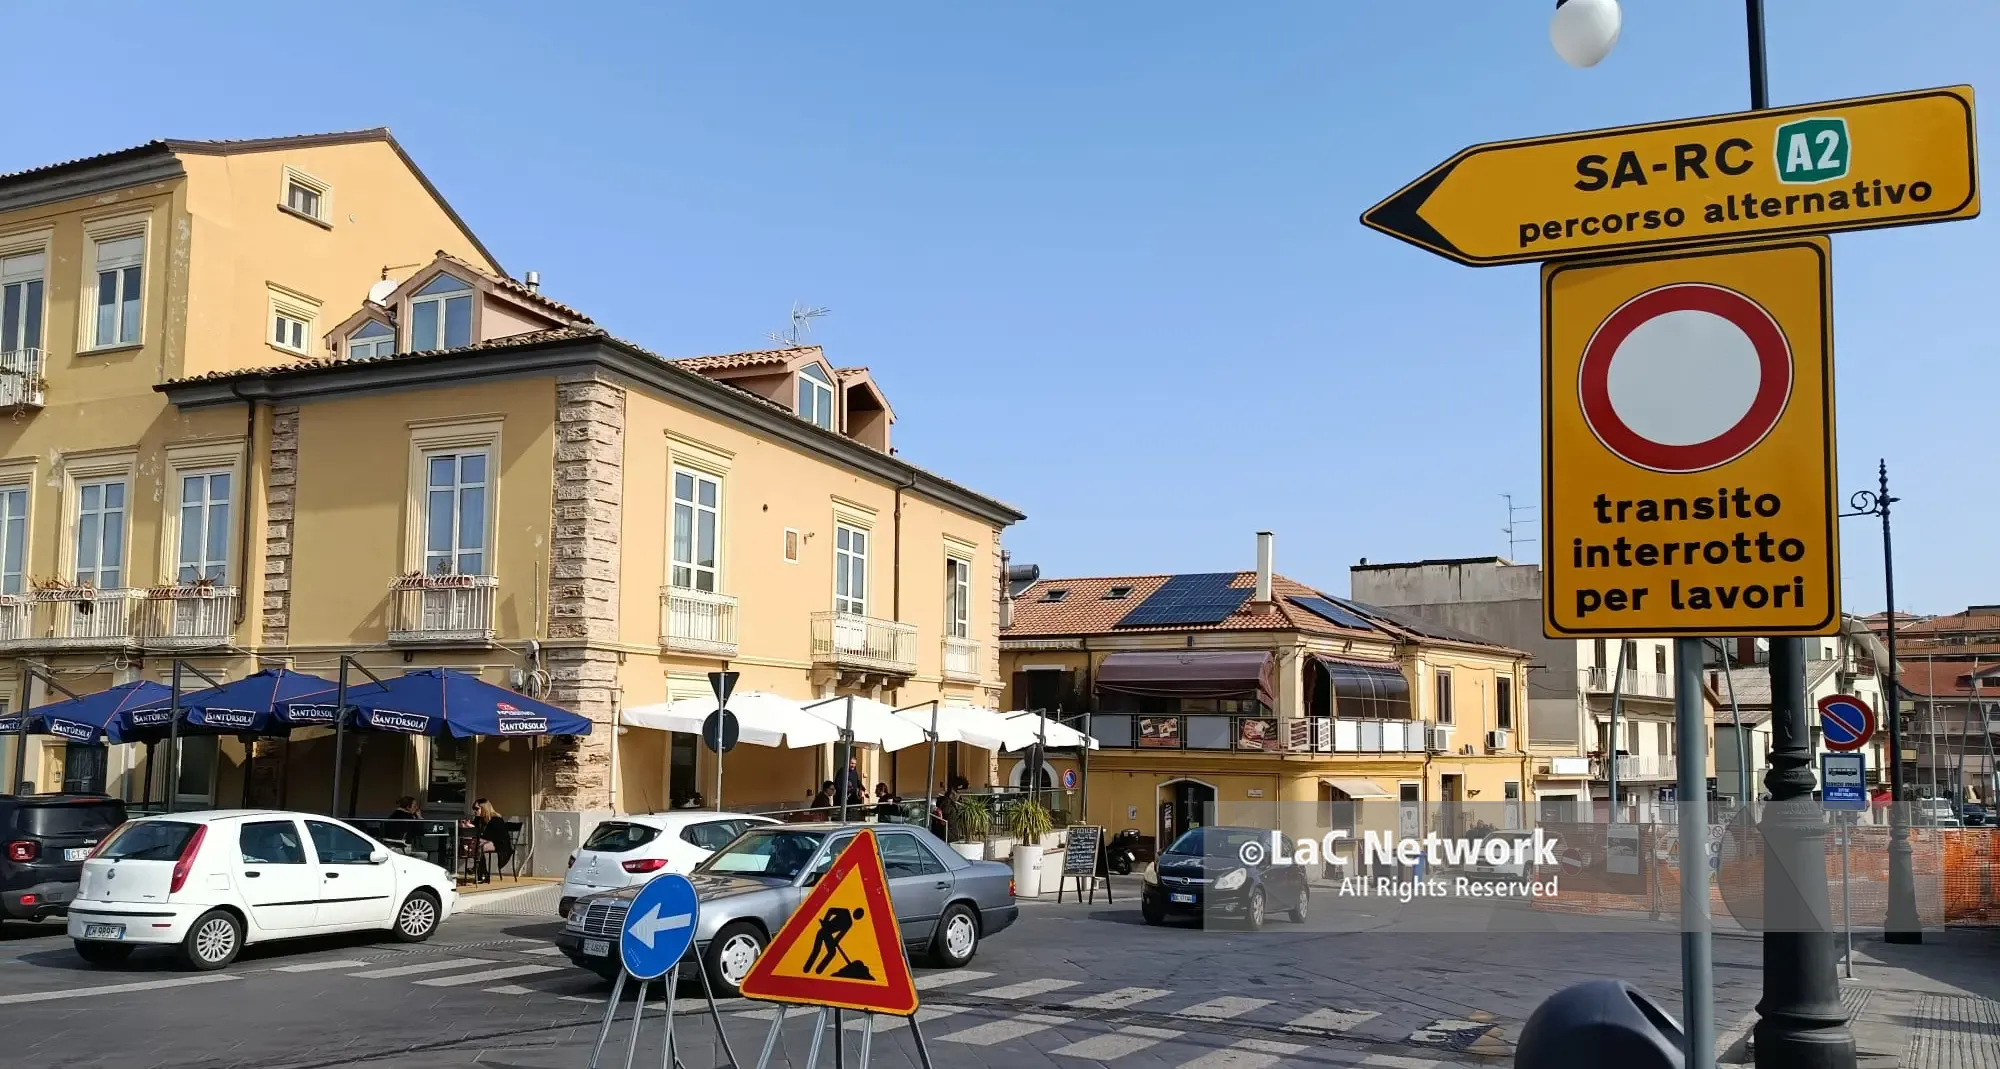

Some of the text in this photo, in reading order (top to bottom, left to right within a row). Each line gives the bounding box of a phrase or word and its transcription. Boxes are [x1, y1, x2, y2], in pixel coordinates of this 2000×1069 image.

[1575, 131, 1840, 191] SA-RC A2
[1520, 180, 1933, 248] percorso alternativo
[1593, 487, 1781, 524] transito
[1573, 531, 1805, 569] interrotto
[1577, 575, 1804, 618] per lavori
